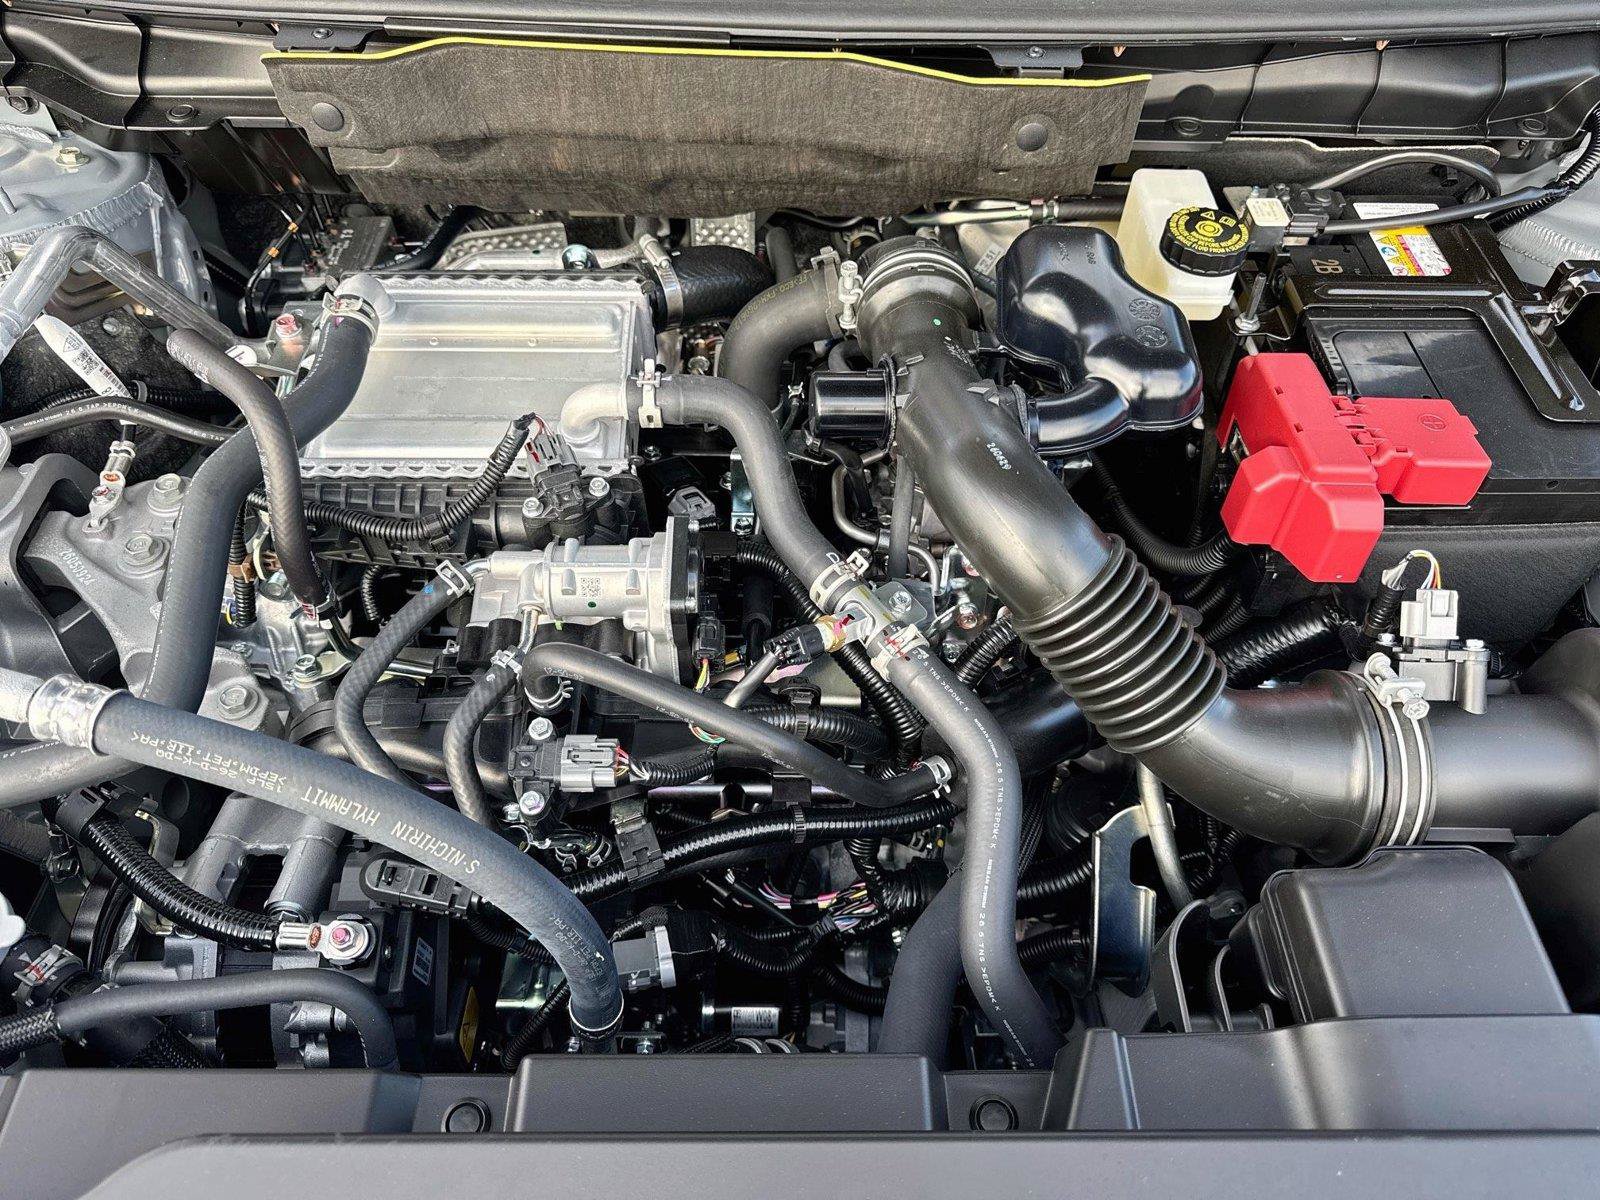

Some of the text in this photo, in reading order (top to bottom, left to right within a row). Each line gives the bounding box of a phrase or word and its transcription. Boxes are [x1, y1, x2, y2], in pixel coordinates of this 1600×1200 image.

[1311, 259, 1344, 274] 2B
[155, 748, 282, 793] 15LP 26-D-K-DQ
[300, 784, 380, 826] HYLAMMIT
